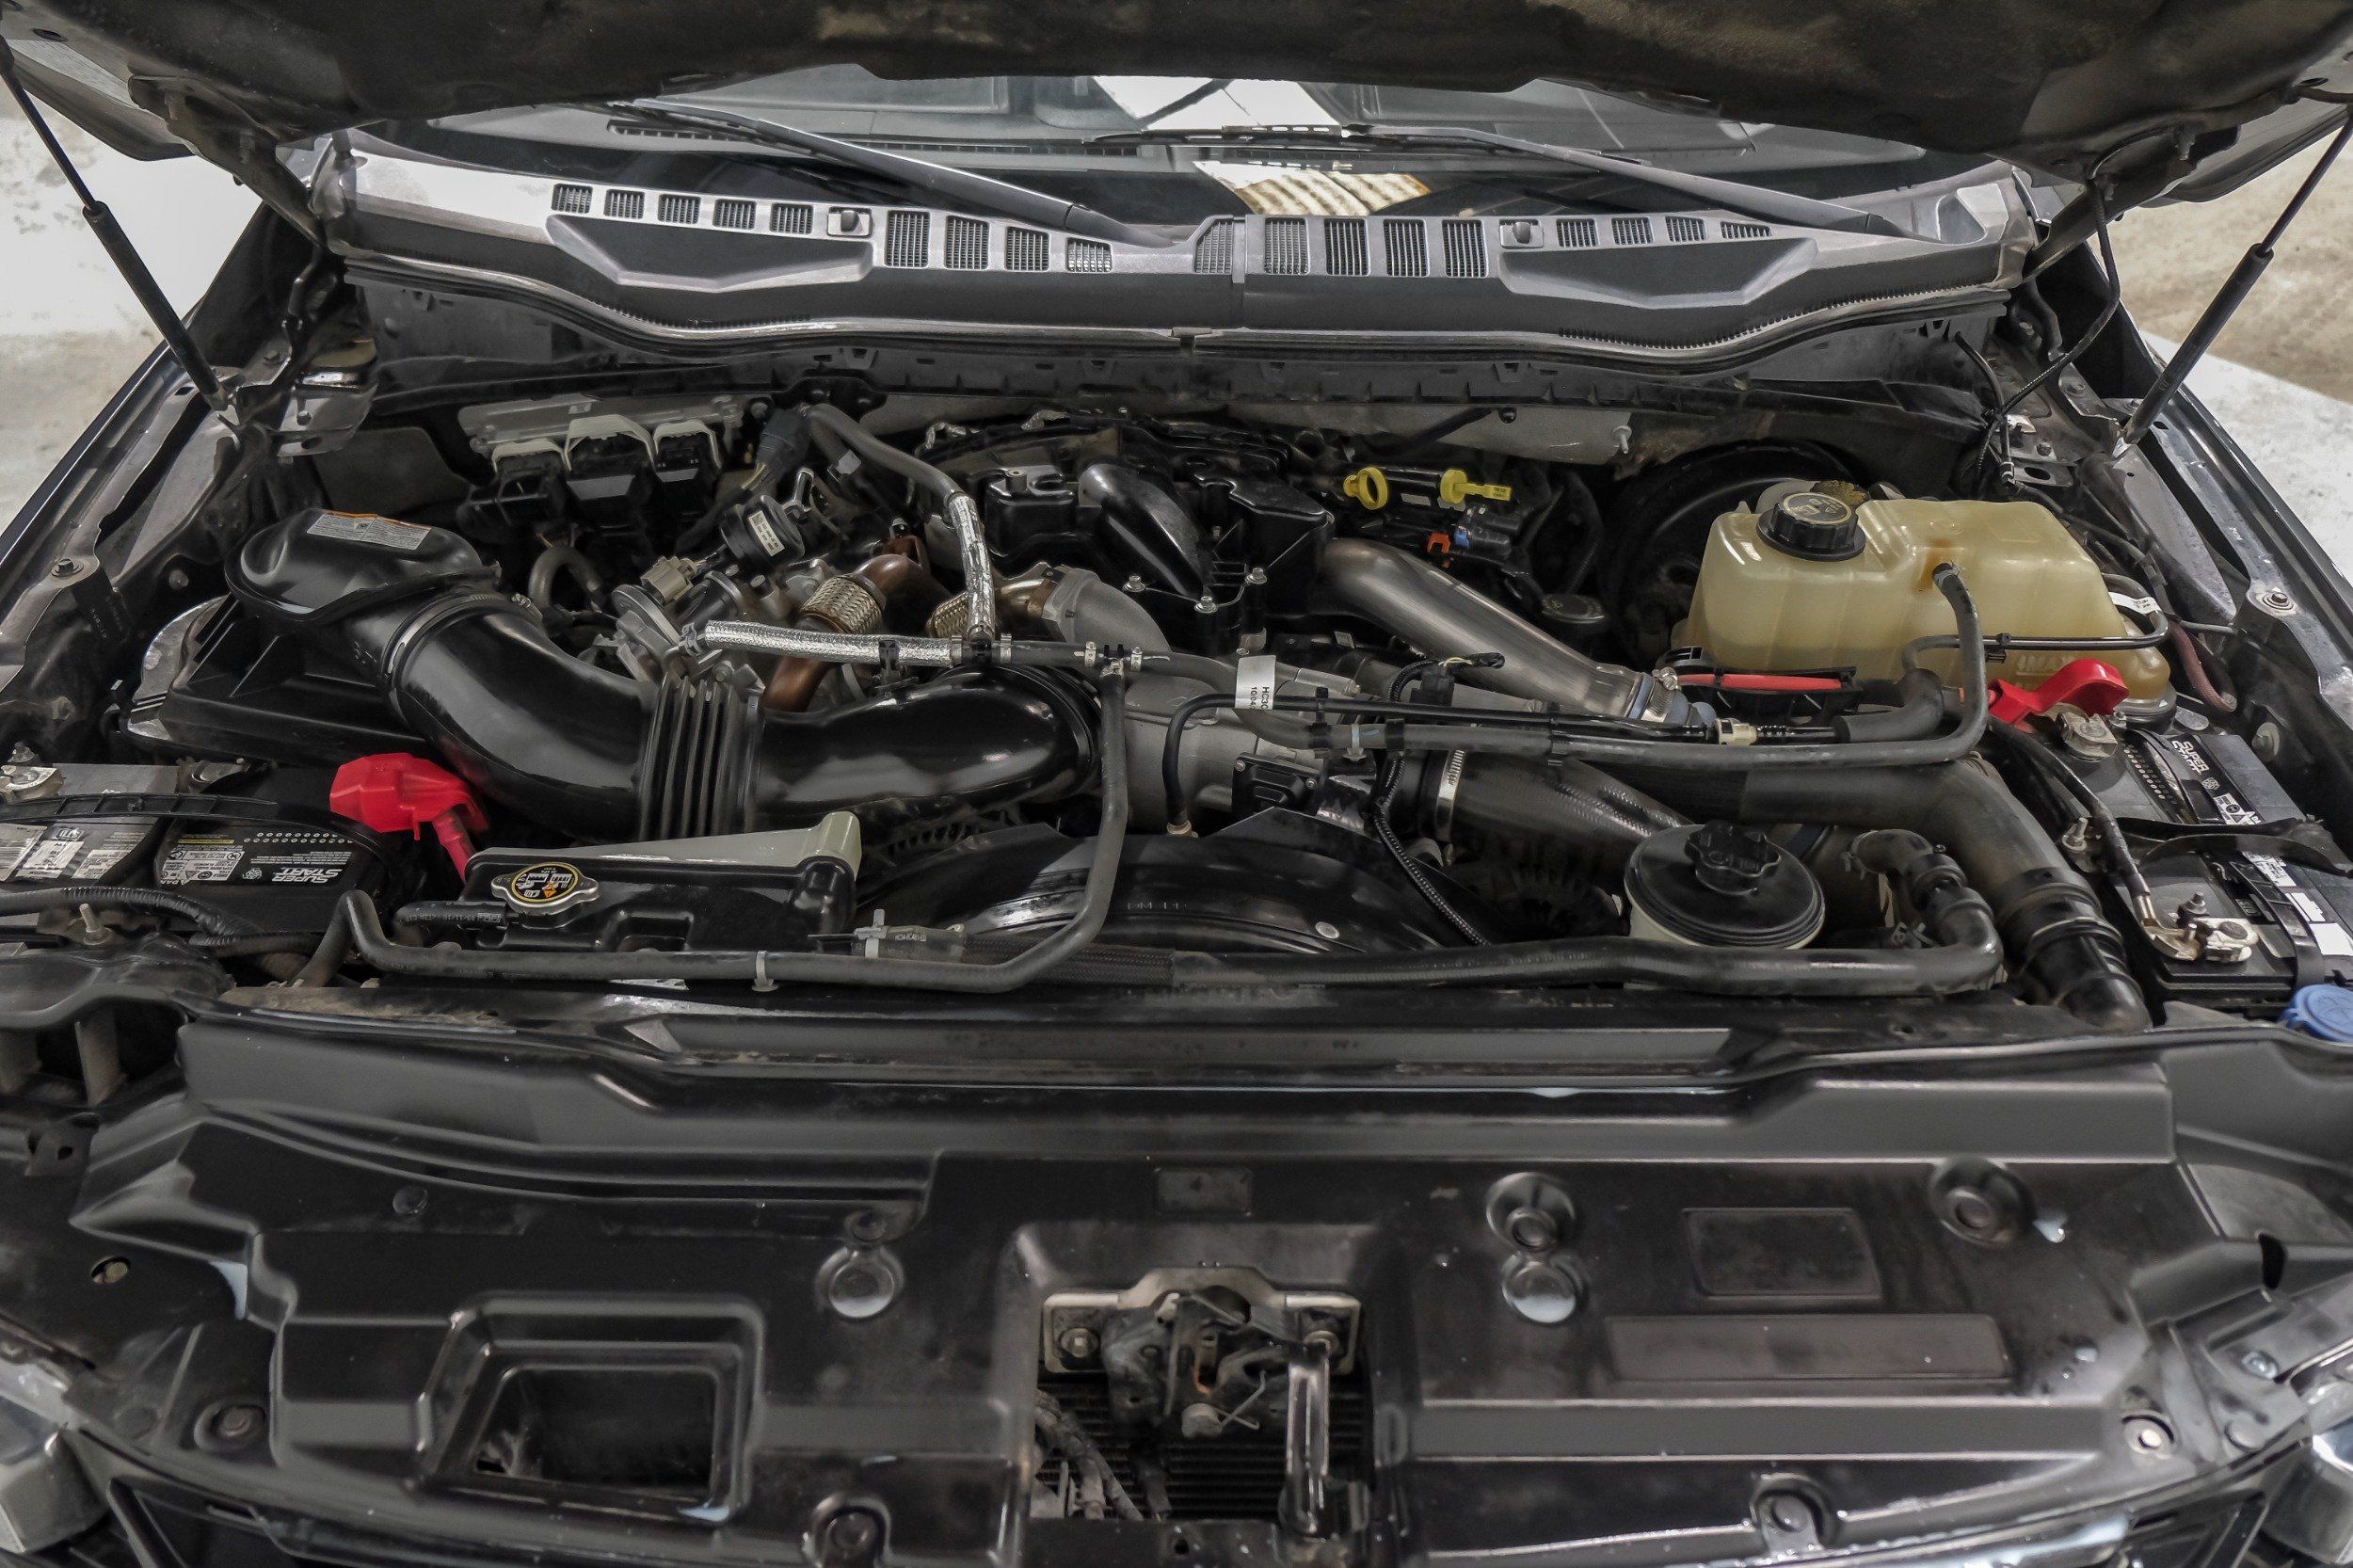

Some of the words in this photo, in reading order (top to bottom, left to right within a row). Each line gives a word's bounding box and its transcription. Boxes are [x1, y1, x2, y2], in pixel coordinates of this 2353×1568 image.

[2183, 741, 2210, 772] SUPER
[275, 867, 343, 877] START
[271, 875, 328, 884] SUPER
